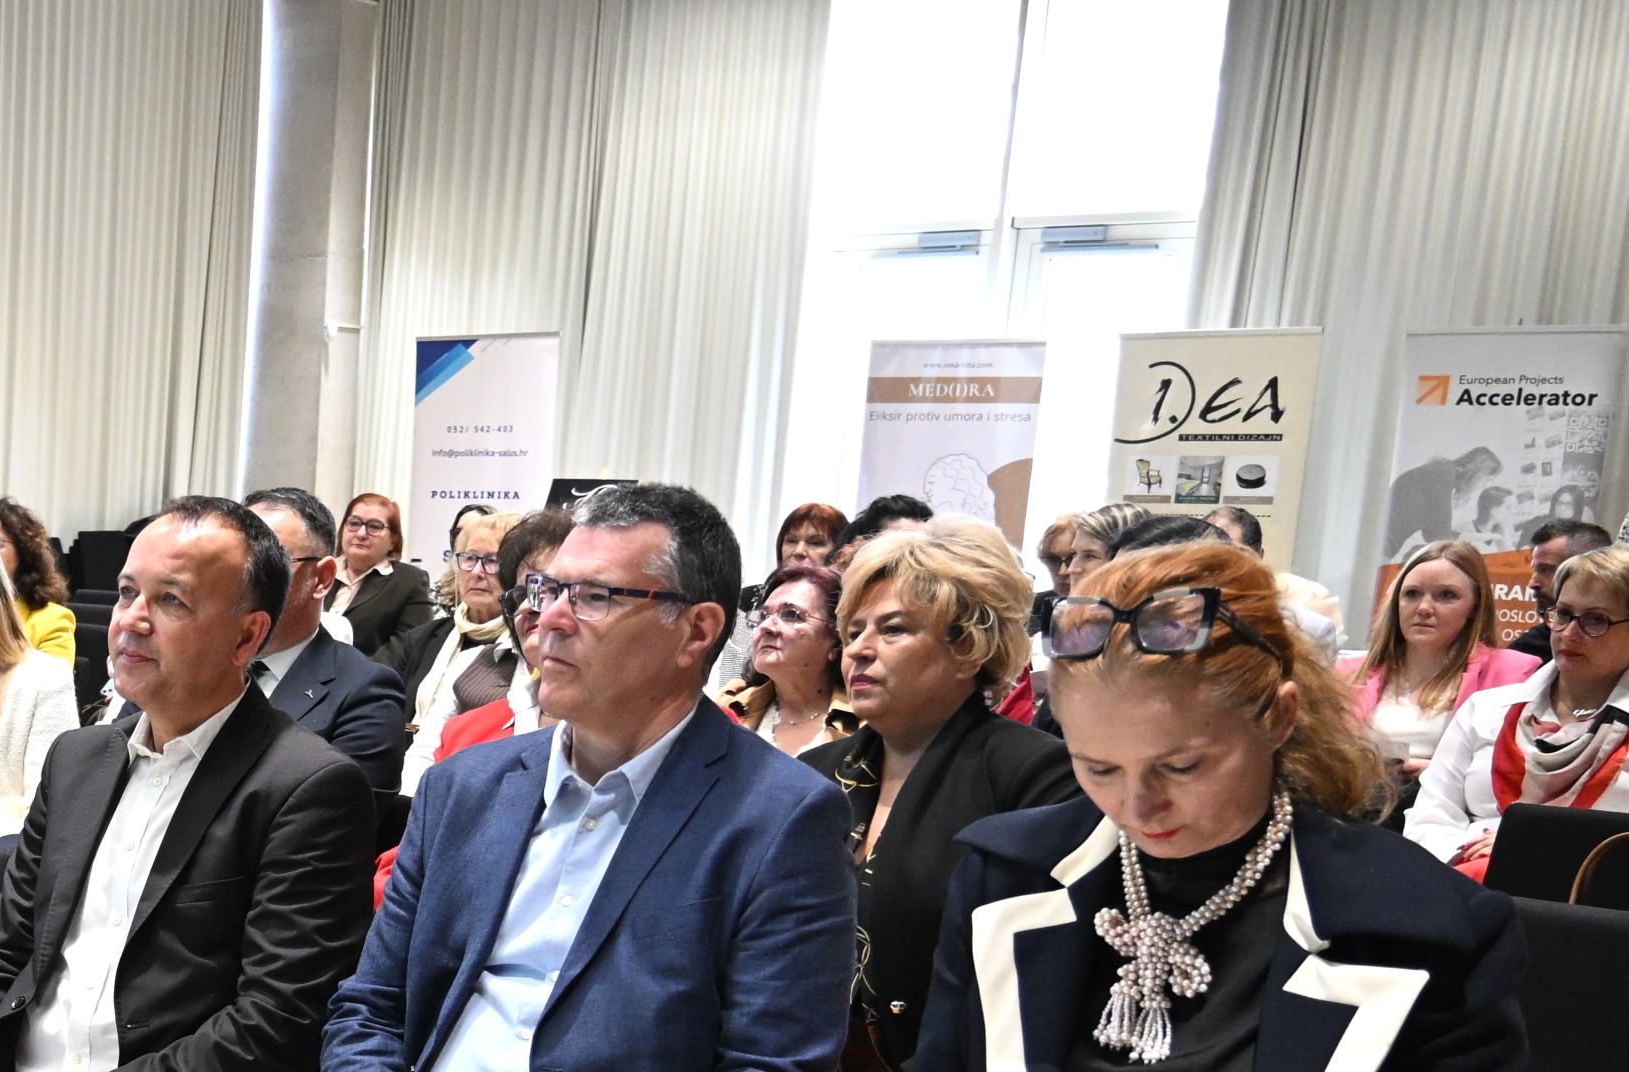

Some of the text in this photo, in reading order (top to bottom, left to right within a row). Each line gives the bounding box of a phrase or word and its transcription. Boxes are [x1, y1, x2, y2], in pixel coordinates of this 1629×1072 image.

[1459, 375, 1564, 387] European Projects
[1456, 388, 1598, 406] Accelerator
[869, 411, 902, 421] Eliksir
[906, 410, 940, 424] protiv
[944, 412, 983, 422] umora
[993, 411, 1032, 422] stresa
[474, 425, 513, 433] 542-403
[431, 490, 520, 499] POLIKLINIKA
